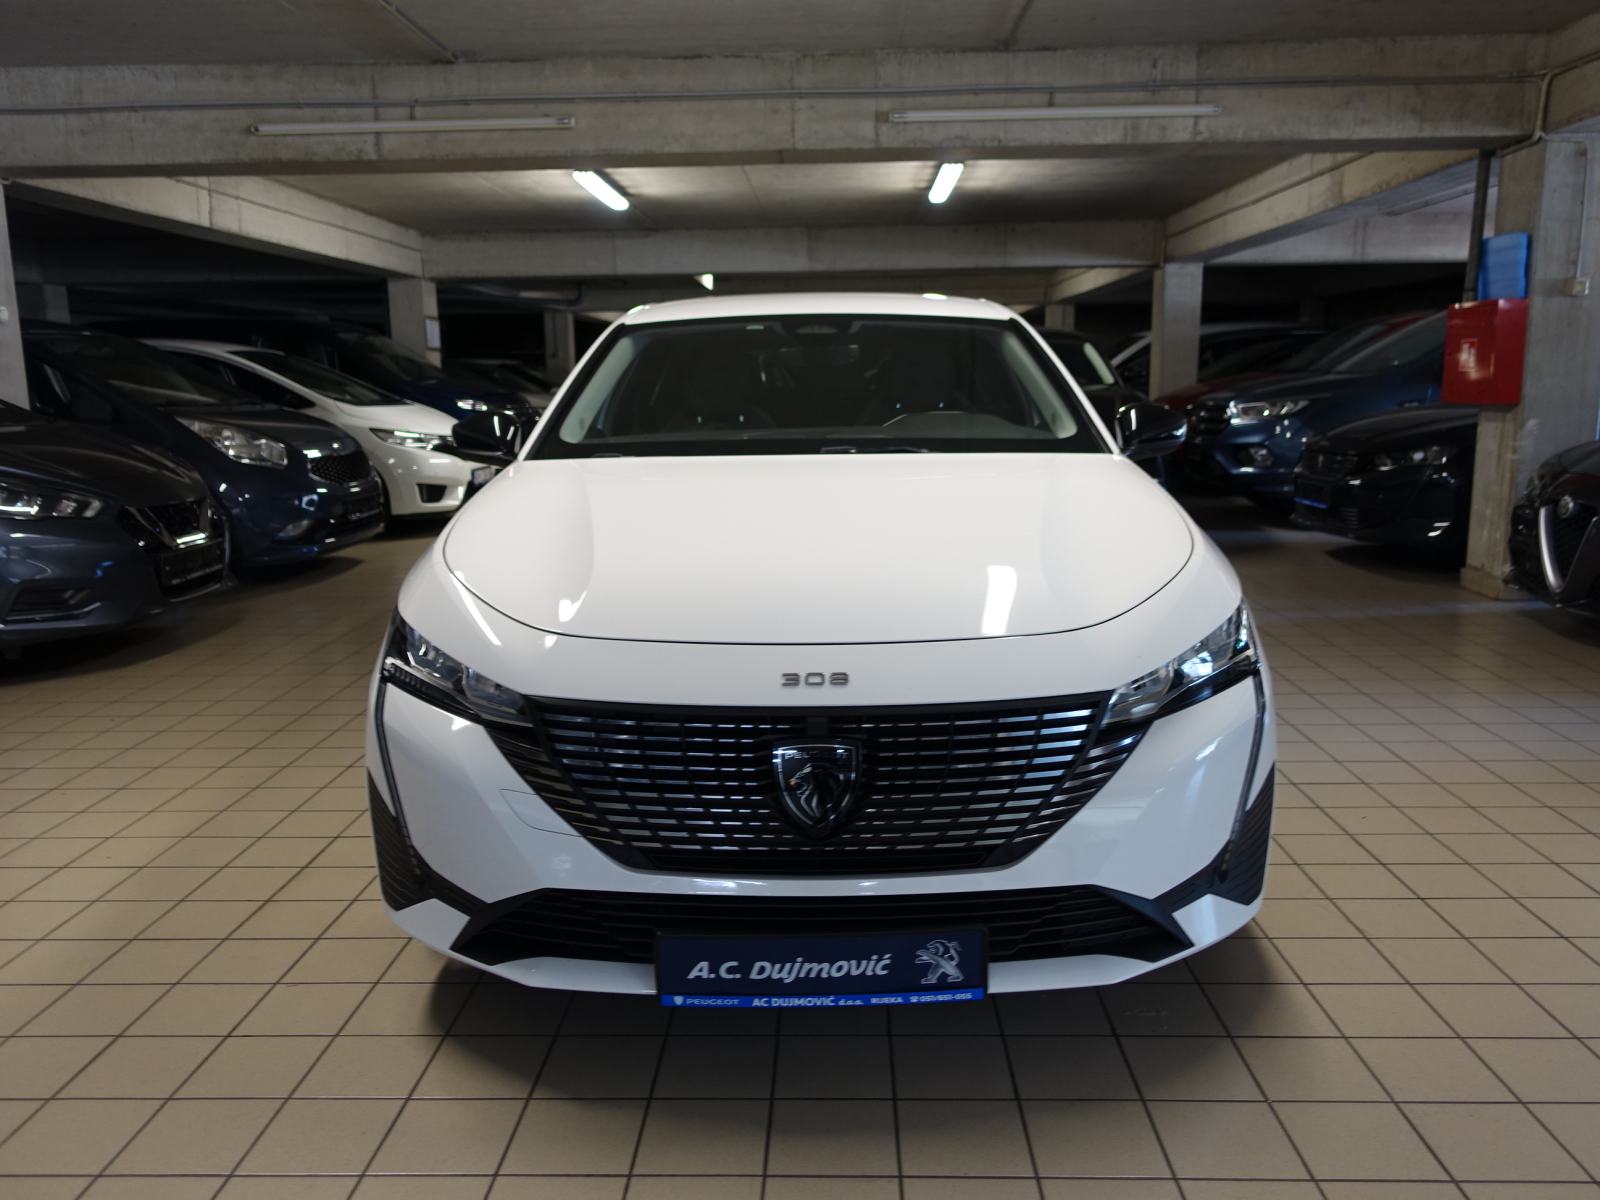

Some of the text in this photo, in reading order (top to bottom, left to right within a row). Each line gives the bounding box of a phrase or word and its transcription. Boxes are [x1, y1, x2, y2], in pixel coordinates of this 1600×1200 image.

[782, 672, 849, 687] 308
[687, 954, 892, 983] A.C. Dujmović
[686, 998, 740, 1006] PEUGEOT
[752, 997, 769, 1007] AC
[771, 995, 835, 1007] DUJMOVIĆ
[870, 997, 904, 1005] RIJEKA
